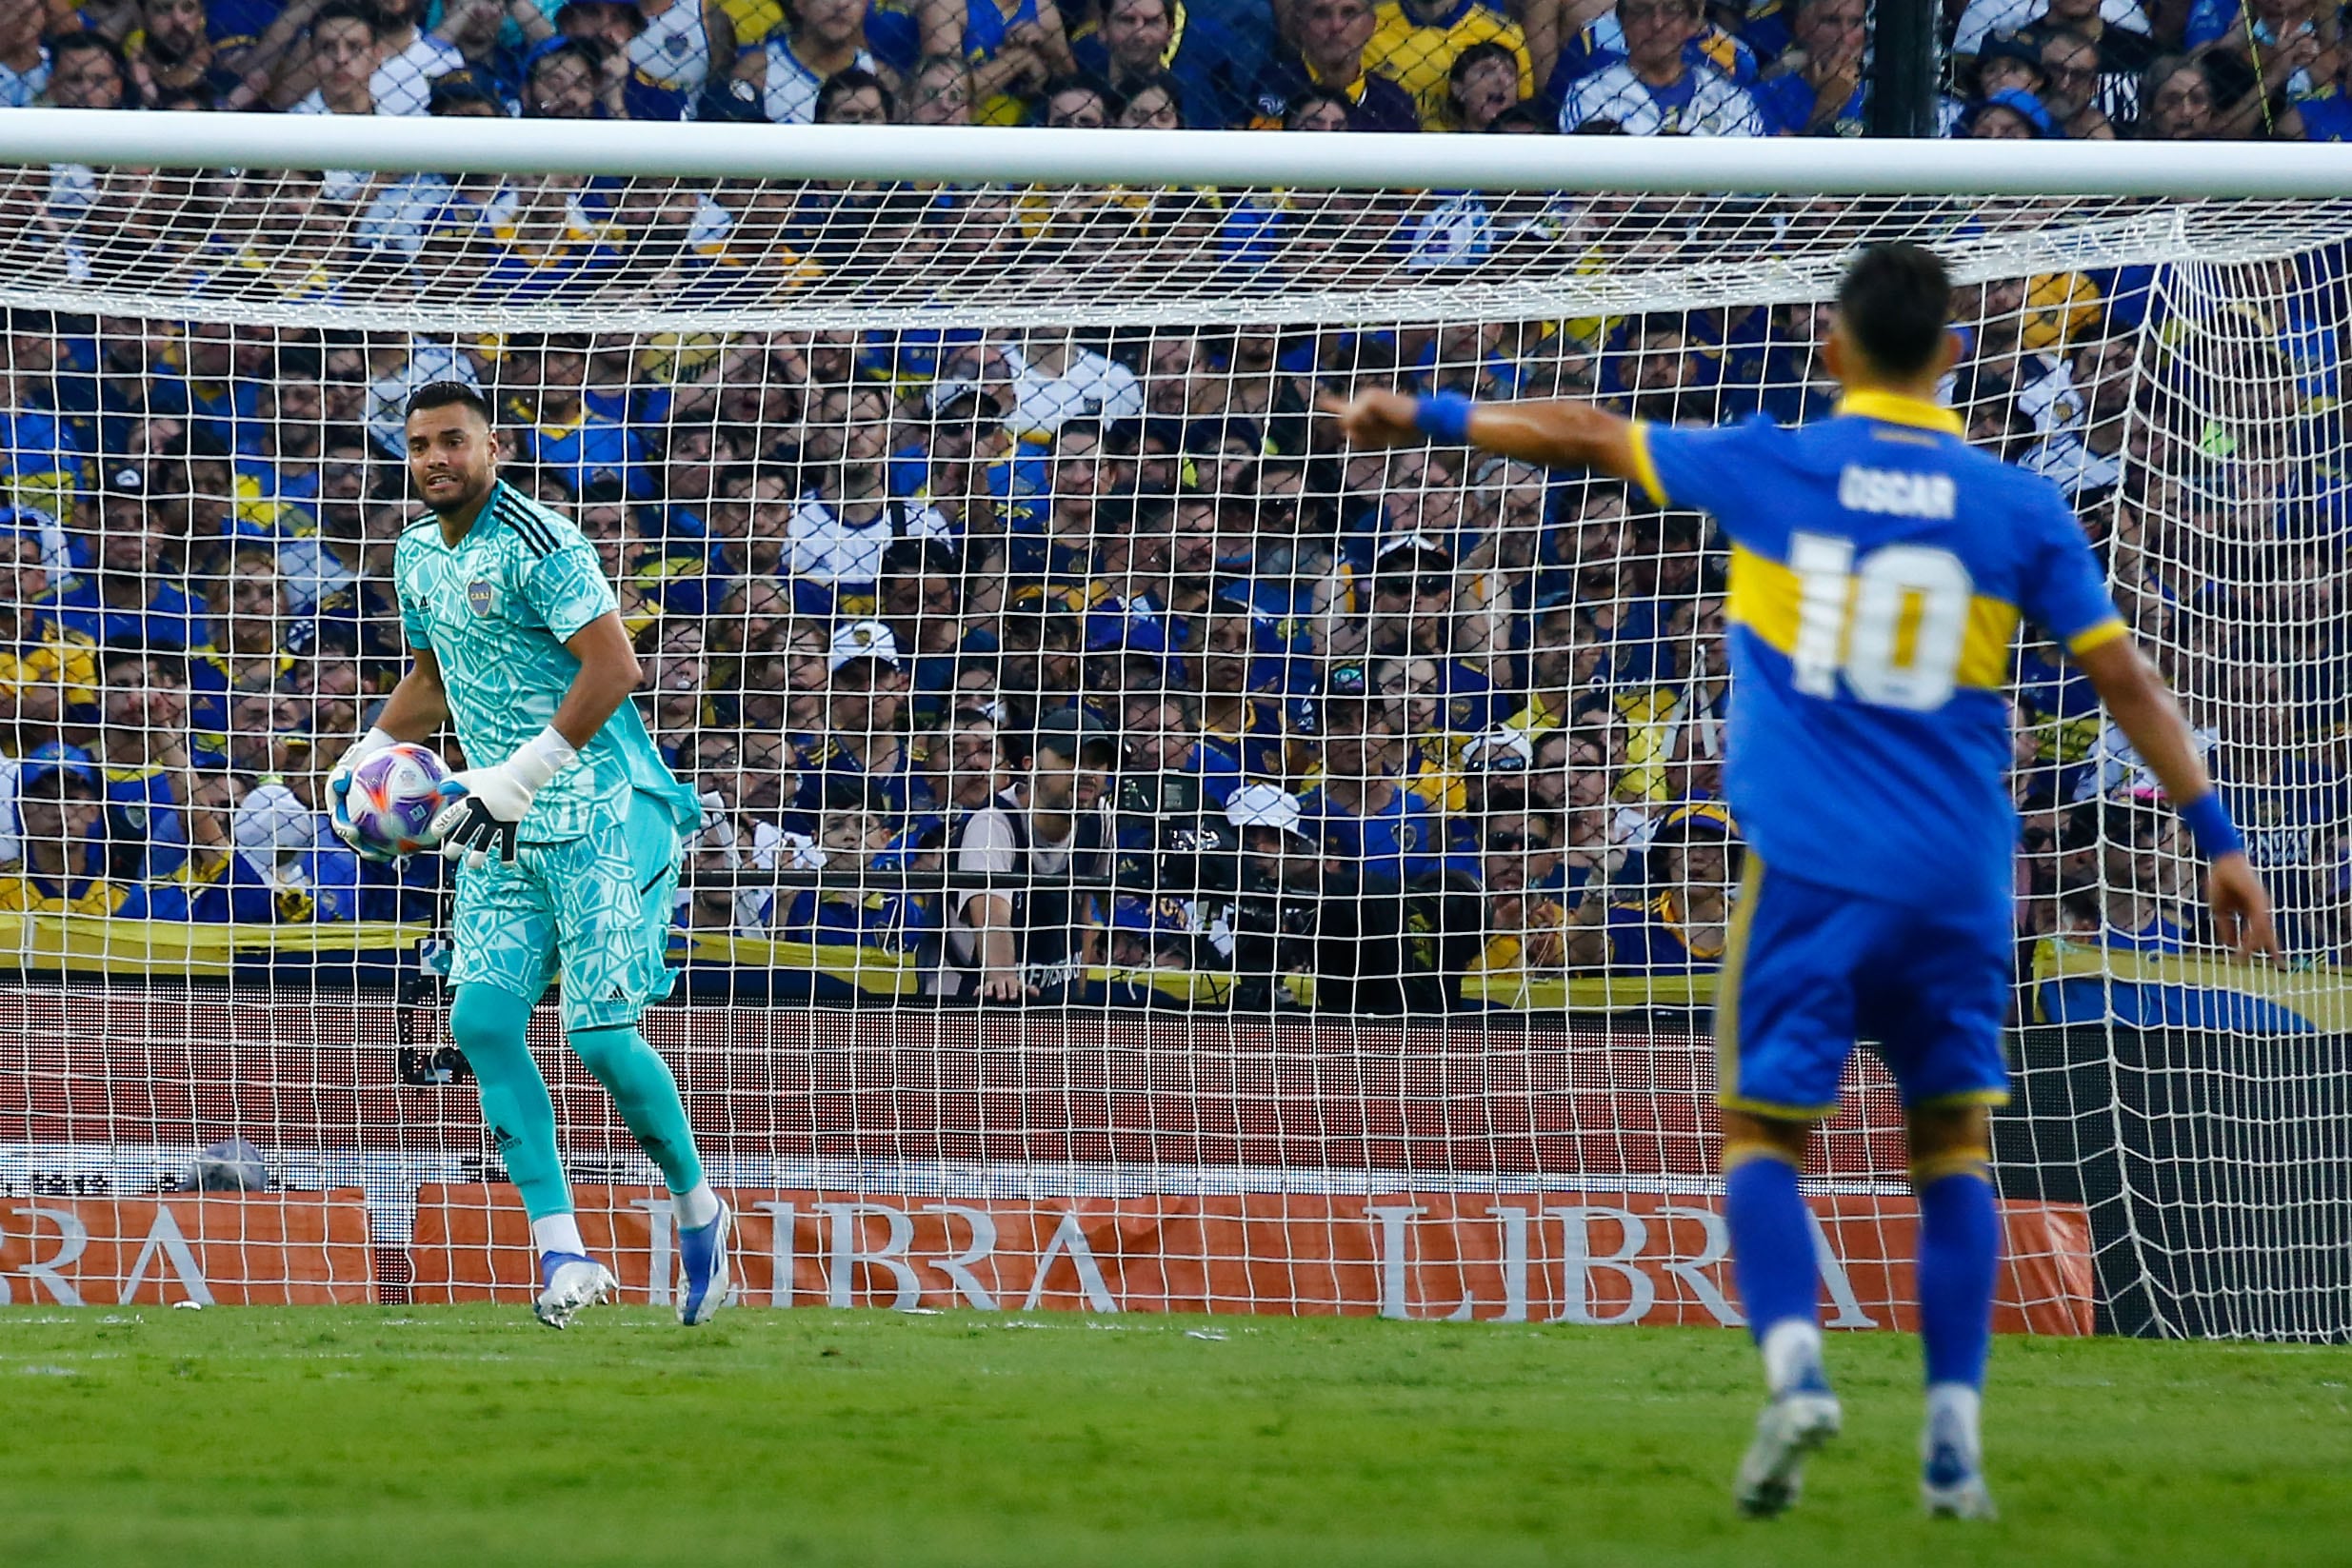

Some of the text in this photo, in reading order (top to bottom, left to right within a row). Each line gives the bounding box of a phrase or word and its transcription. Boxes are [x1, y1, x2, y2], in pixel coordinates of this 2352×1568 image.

[1838, 465, 1957, 521] OSCAR
[1789, 531, 1974, 712] 10
[0, 1204, 216, 1306] RA
